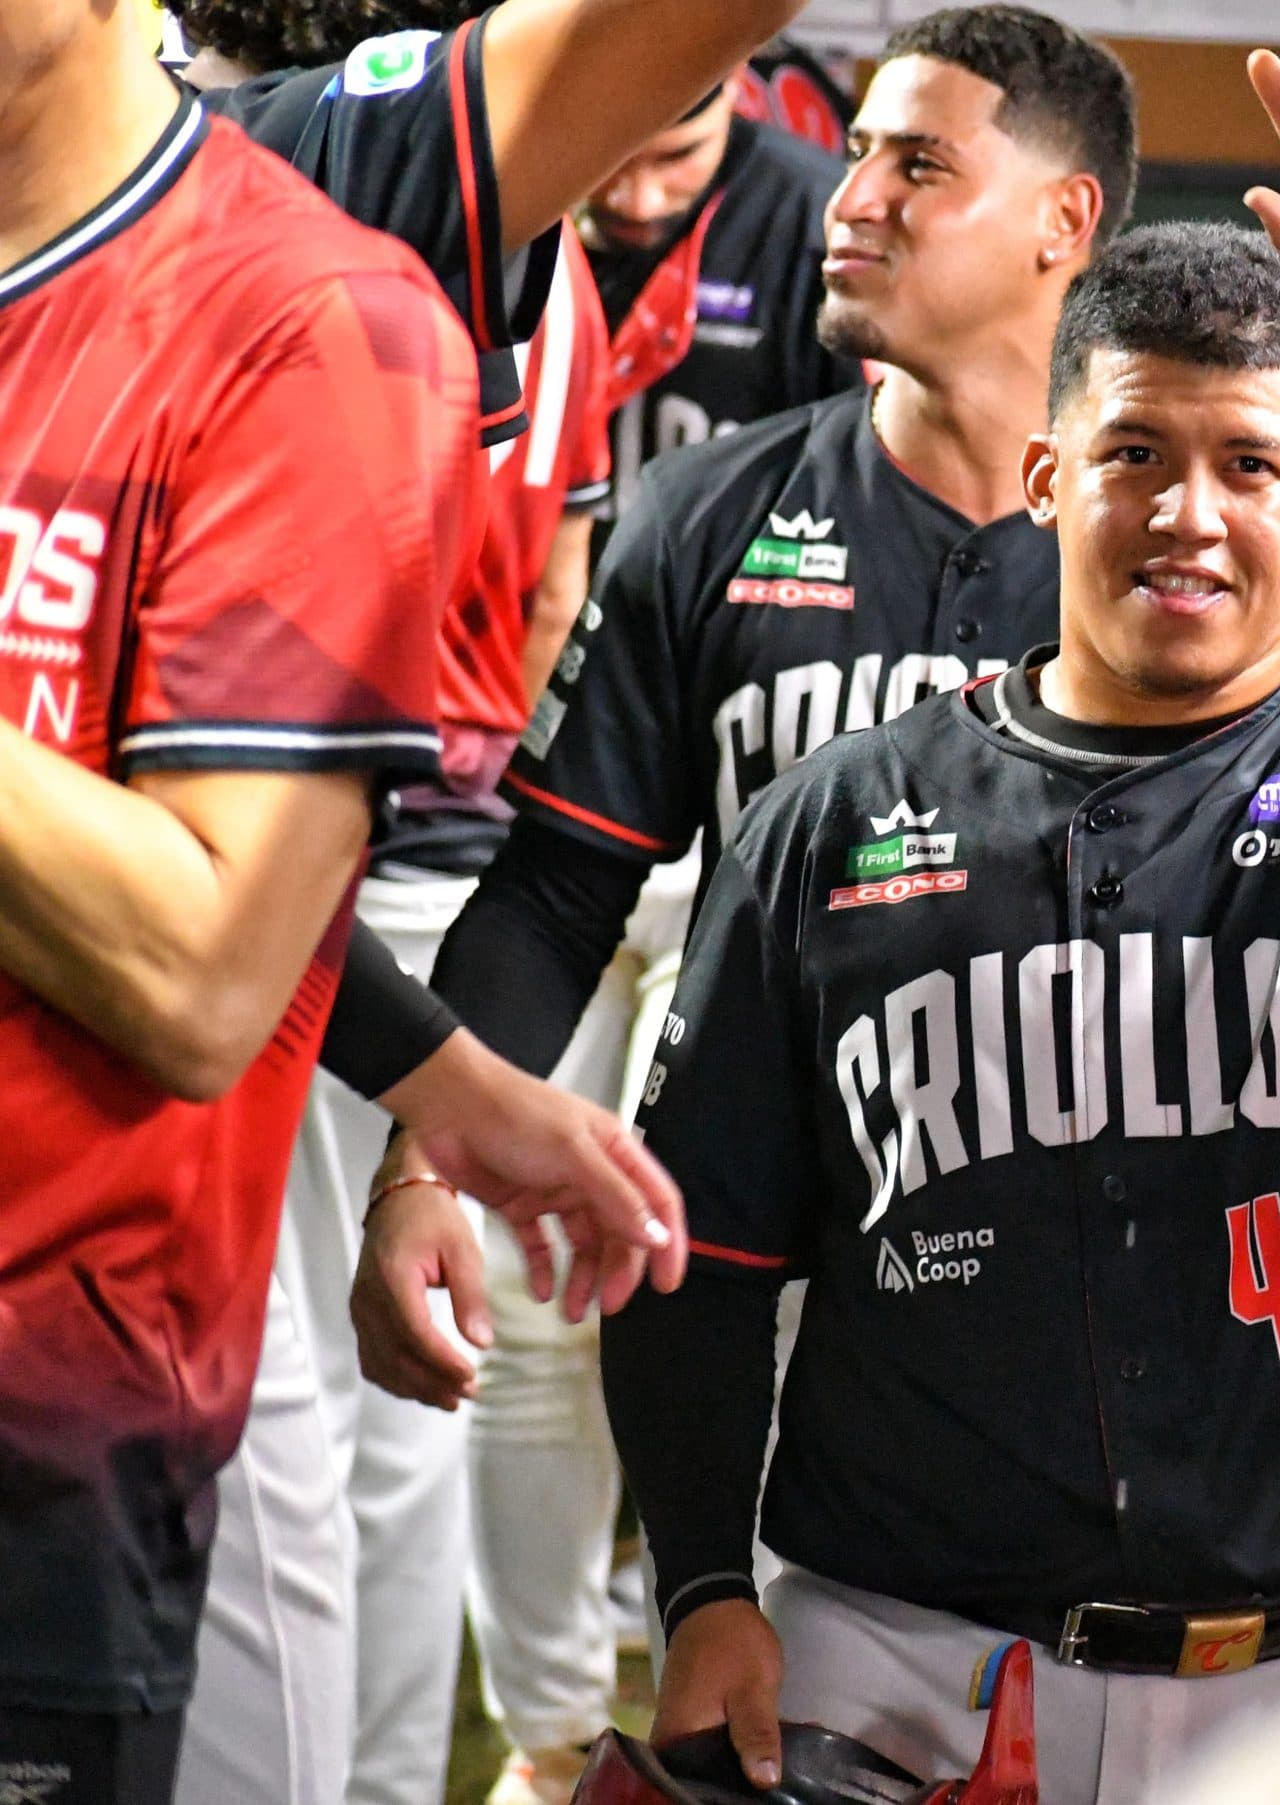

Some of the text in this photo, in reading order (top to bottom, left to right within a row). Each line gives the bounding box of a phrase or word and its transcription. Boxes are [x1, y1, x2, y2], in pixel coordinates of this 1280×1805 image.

[732, 580, 851, 605] ECONO
[906, 843, 947, 857] Bank
[834, 873, 964, 906] ECONO
[911, 1227, 996, 1256] Buena
[916, 1256, 981, 1286] Coop
